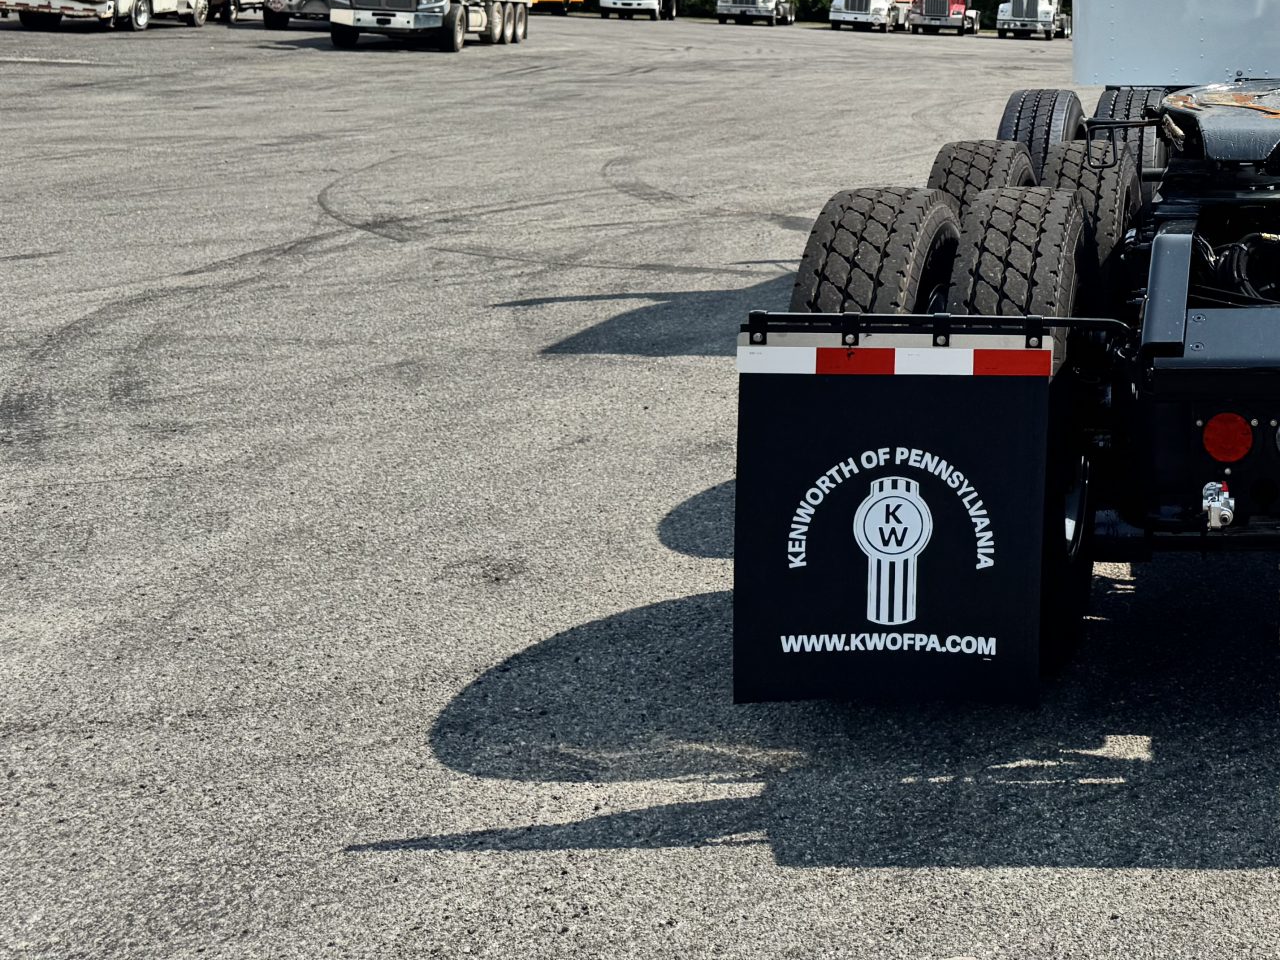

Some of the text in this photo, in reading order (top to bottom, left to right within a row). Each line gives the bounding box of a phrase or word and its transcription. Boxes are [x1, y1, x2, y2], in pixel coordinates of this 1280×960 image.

[787, 446, 995, 570] KENWORTH OF PENNSYLVANIA
[885, 503, 903, 525] K
[878, 526, 909, 548] W
[780, 632, 997, 656] WWW.KWOFPA.COM
